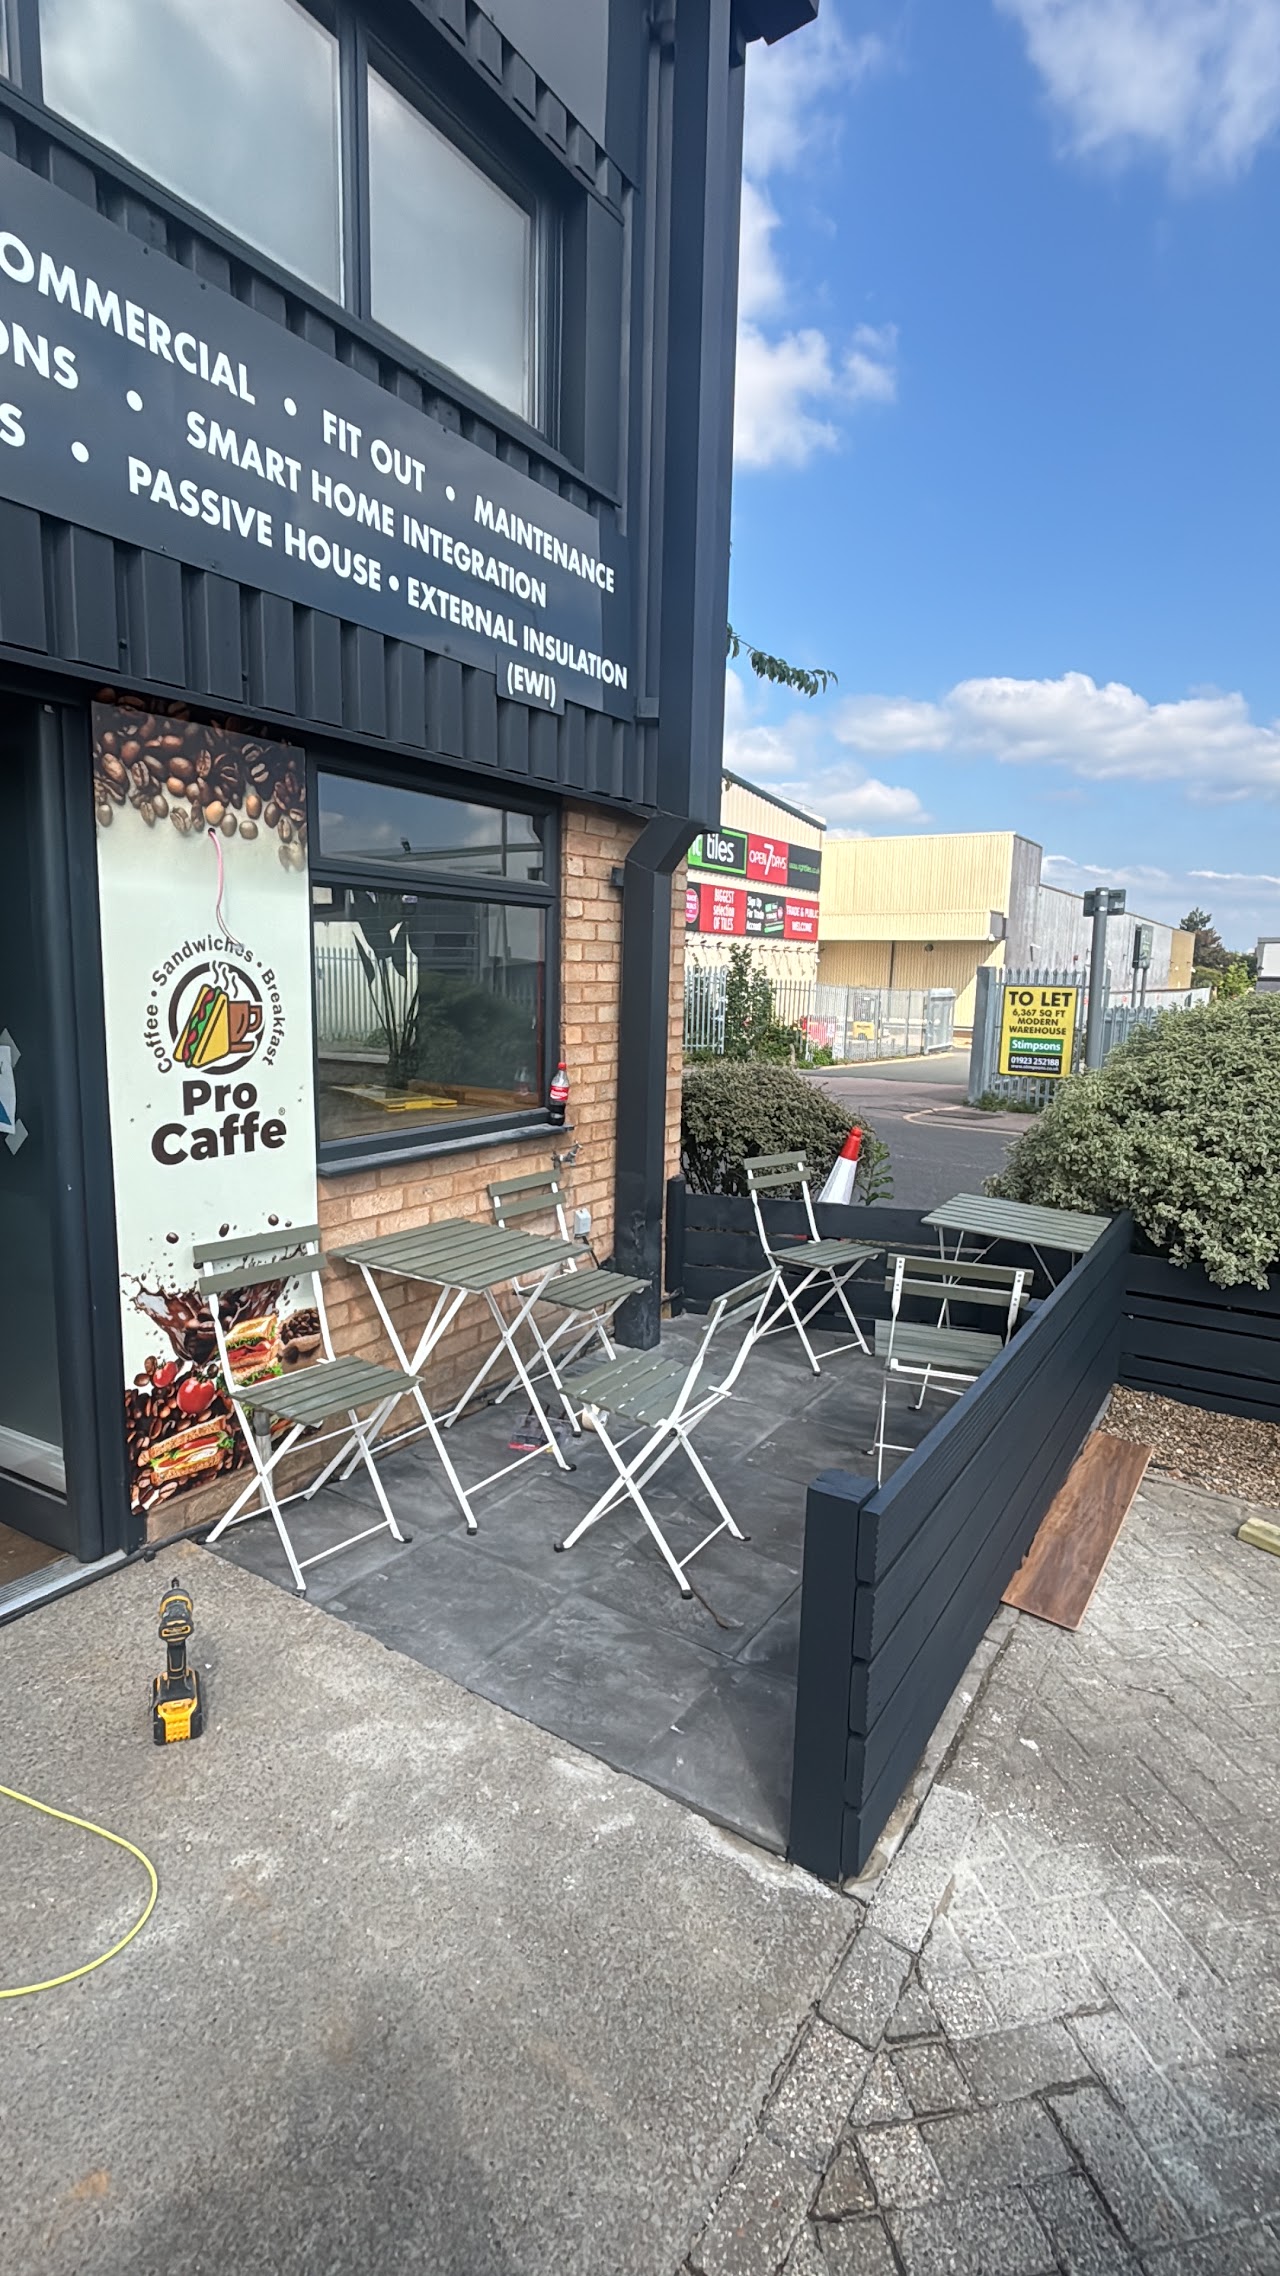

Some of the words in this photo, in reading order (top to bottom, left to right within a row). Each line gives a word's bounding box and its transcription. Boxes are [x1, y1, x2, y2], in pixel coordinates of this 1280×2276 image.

[186, 411, 301, 493] SMART
[312, 469, 395, 537] HOME
[403, 514, 547, 608] INTEGRATION
[323, 409, 362, 459] FIT
[371, 439, 426, 493] OUT
[474, 495, 615, 593] MAINTENANCE
[128, 456, 272, 547] PASSIVE
[285, 522, 381, 592] HOUSE
[408, 577, 518, 646] EXTERNAL
[523, 625, 627, 689] INSULATION
[507, 662, 556, 708] (EWI)
[707, 833, 734, 863] tiles
[749, 850, 767, 866] OPEN
[764, 843, 774, 875] 7
[771, 855, 787, 869] DAYS
[714, 888, 735, 904] BIGGEST
[152, 934, 254, 987] Sandwiches
[1009, 991, 1034, 1006] TO
[1041, 992, 1072, 1007] LET
[1012, 1008, 1037, 1017] 6,367
[1039, 1009, 1053, 1017] SQ
[261, 968, 286, 1066] Breakfast
[1009, 1025, 1067, 1035] WAREHOUSE
[1017, 1018, 1059, 1026] MODERN
[144, 1004, 173, 1074] Coffee
[1012, 1039, 1061, 1052] Stimpsons
[1010, 1056, 1032, 1065] 01923
[1033, 1058, 1060, 1067] 252188
[182, 1080, 257, 1116] Pro
